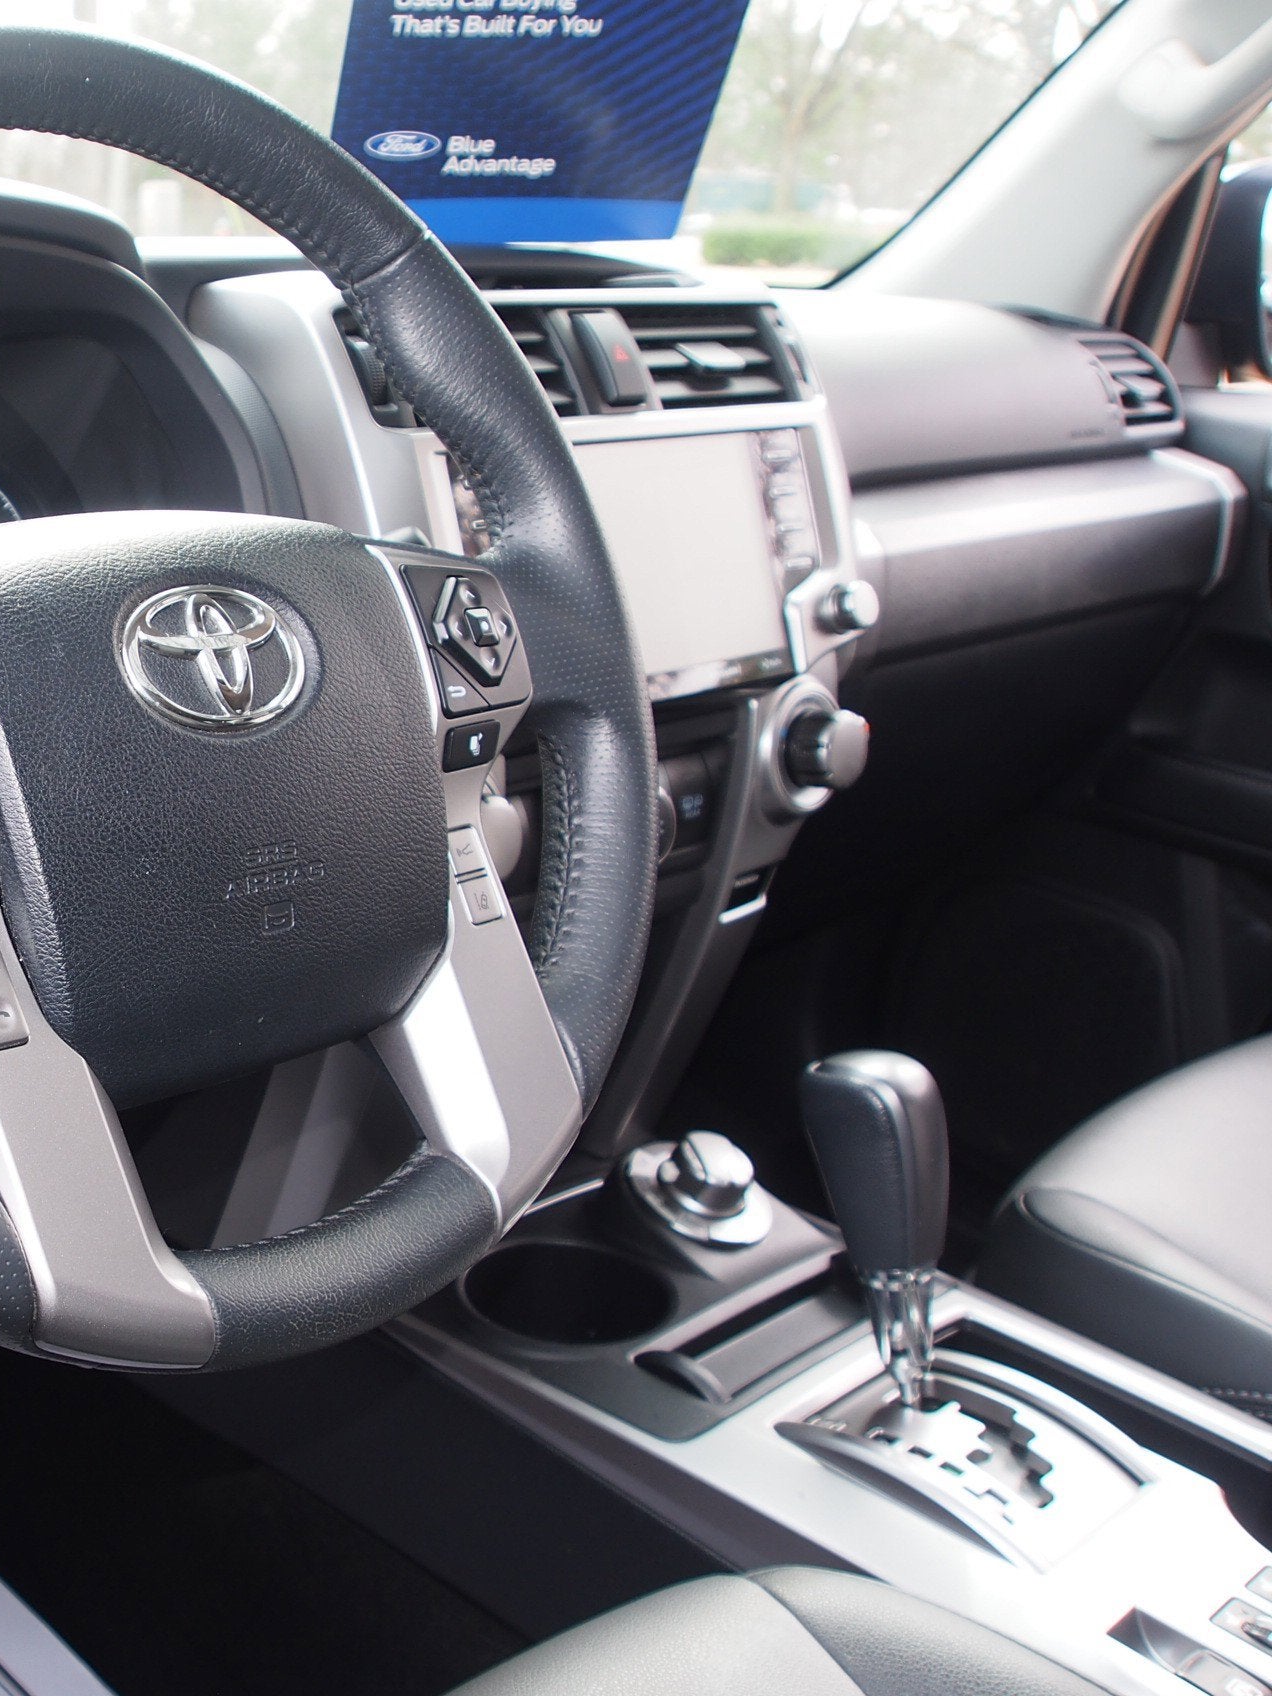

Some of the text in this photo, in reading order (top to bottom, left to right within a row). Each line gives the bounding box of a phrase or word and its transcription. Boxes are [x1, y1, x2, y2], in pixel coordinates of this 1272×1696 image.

[389, 14, 604, 38] That's Built For You
[444, 135, 496, 157] Blue
[441, 155, 557, 179] Advantage
[226, 861, 325, 899] AIRBAG
